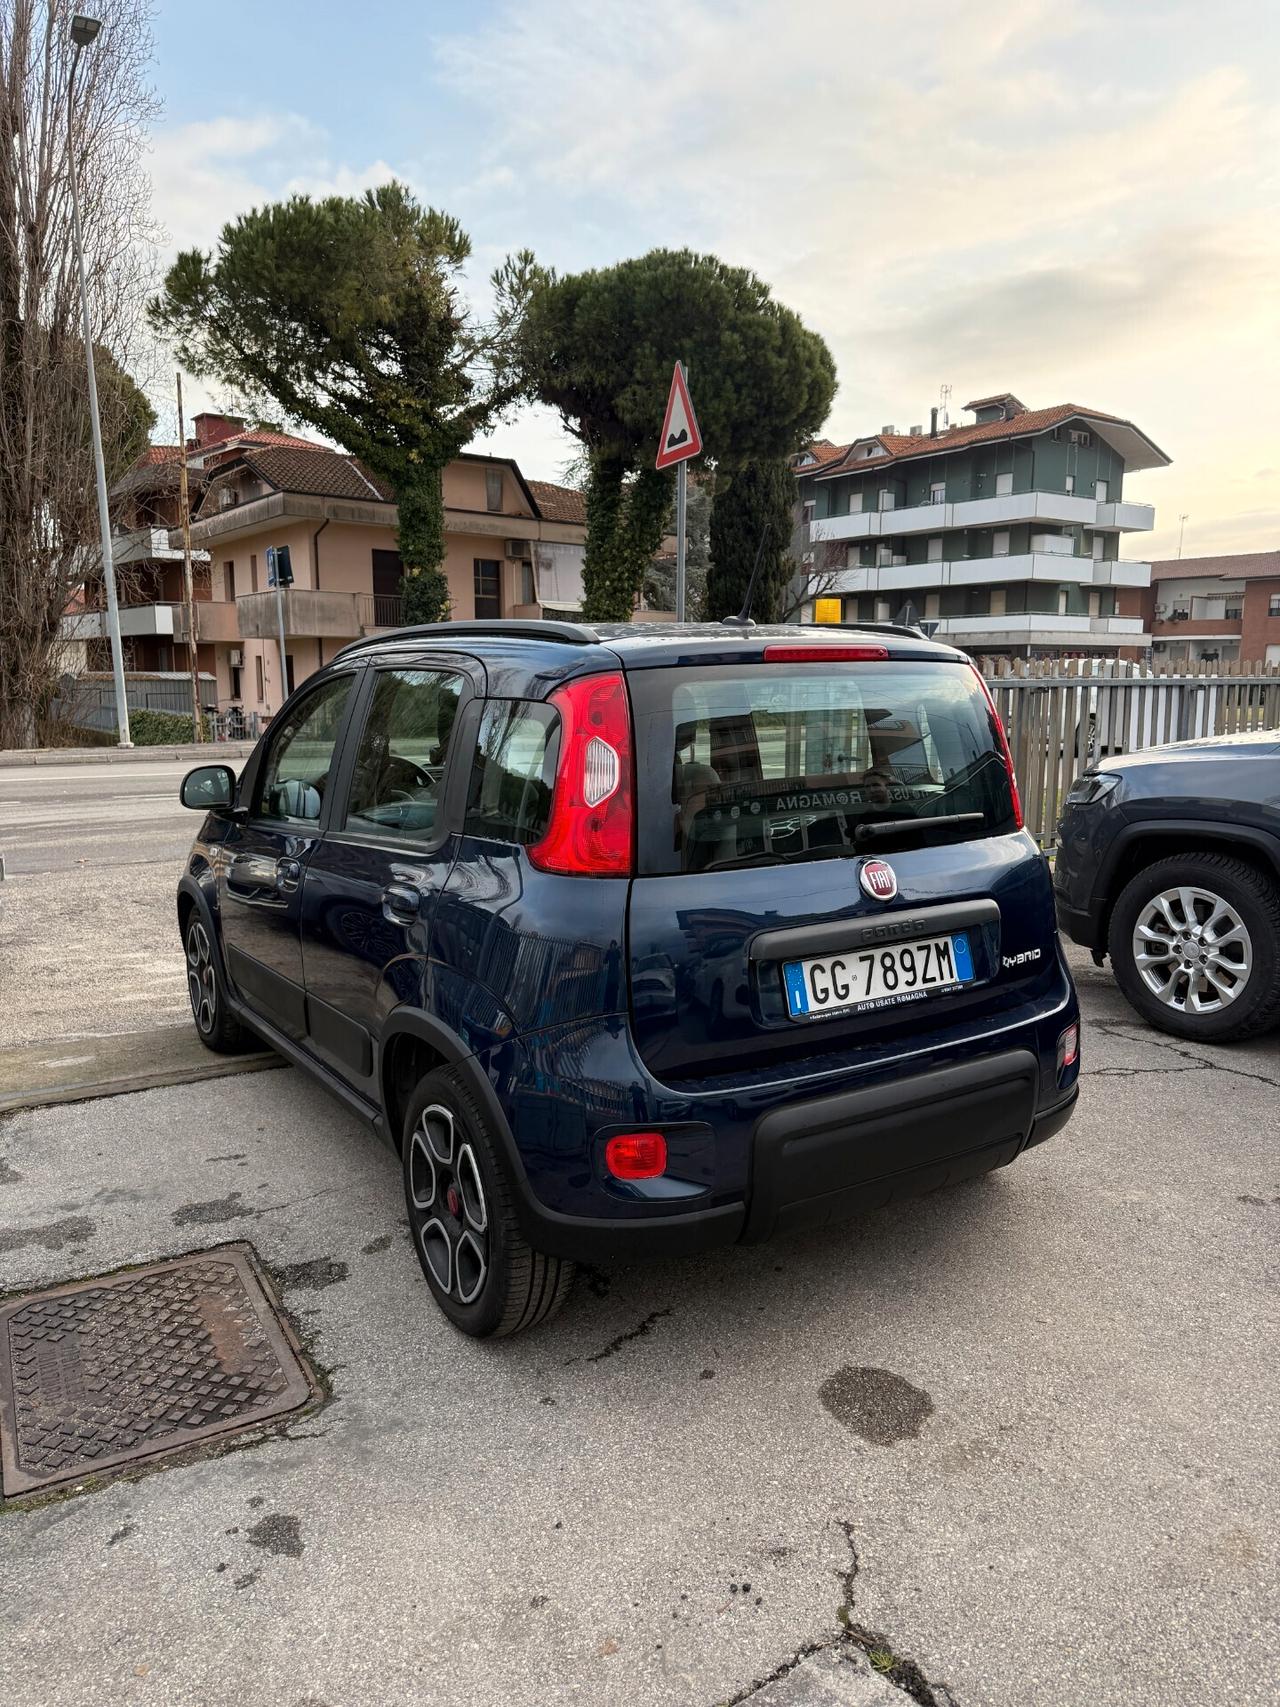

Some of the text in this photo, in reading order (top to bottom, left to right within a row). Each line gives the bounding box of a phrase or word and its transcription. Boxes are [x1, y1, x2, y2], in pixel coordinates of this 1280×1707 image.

[869, 870, 891, 890] FIAT
[809, 941, 955, 1004] GG 789ZM
[876, 997, 896, 1007] USATE
[897, 992, 928, 1003] ROMAGNA
